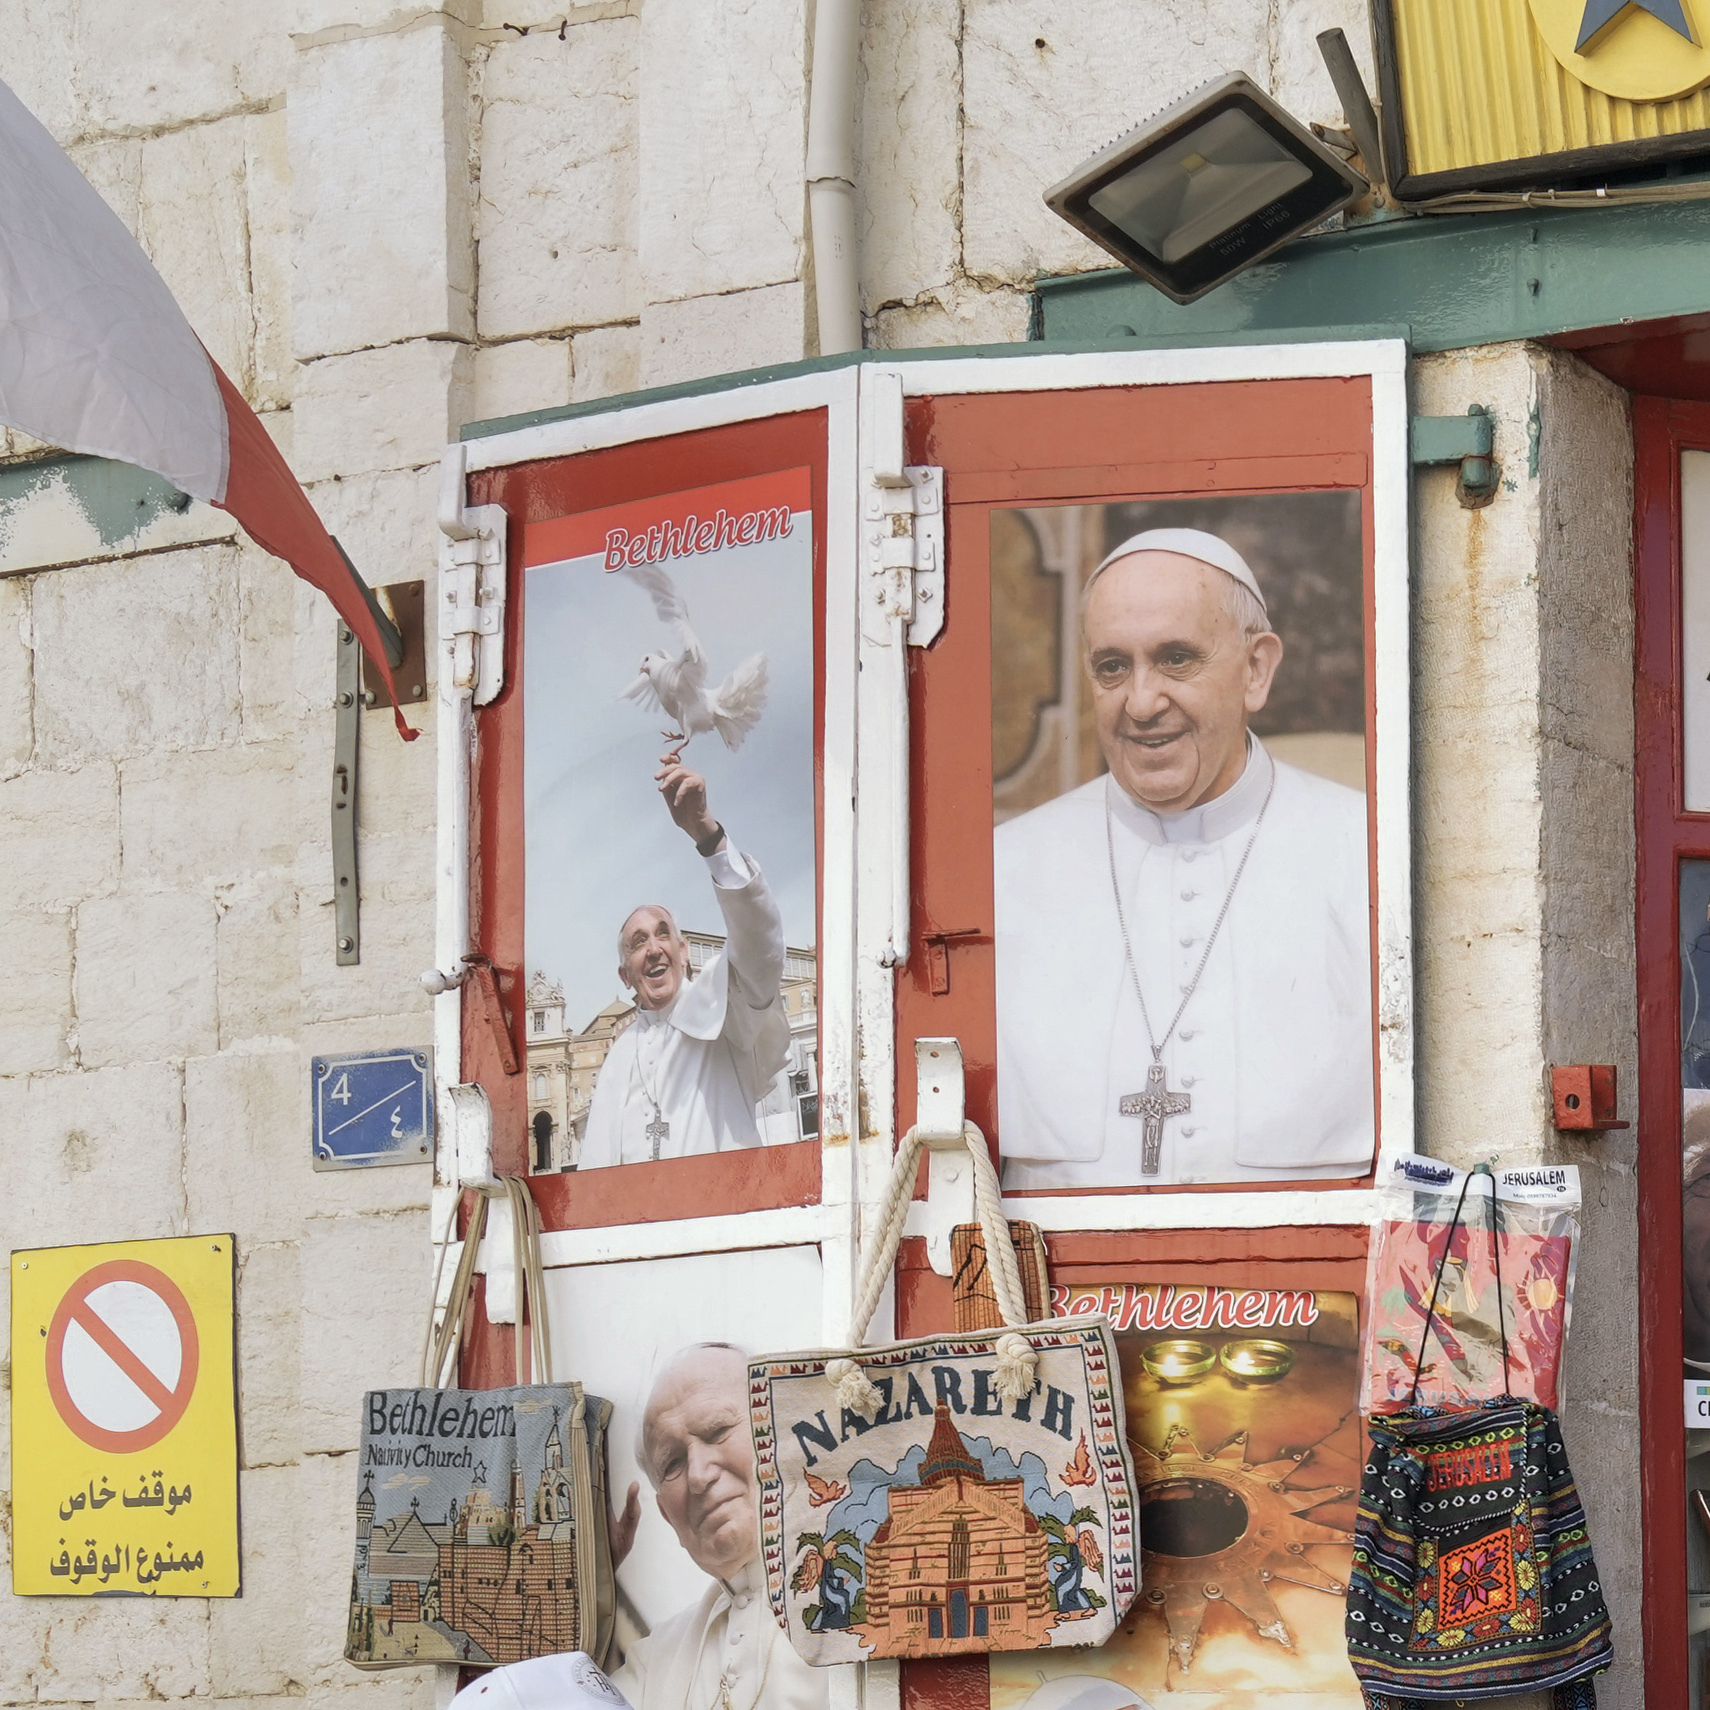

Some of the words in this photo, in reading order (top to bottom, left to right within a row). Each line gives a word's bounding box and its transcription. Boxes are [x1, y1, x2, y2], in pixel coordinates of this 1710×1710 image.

[605, 504, 793, 573] Bethlehem
[331, 1073, 352, 1106] 4
[390, 1105, 403, 1138] ٤
[1502, 1170, 1566, 1186] JERUSALEM
[368, 1391, 516, 1439] Bethlehem
[365, 1439, 413, 1468] Nativity
[413, 1443, 473, 1468] Church
[1427, 1440, 1512, 1492] JERUSALEM
[59, 1476, 116, 1521] خاص
[122, 1470, 192, 1516] موقف
[50, 1537, 130, 1585] الوقوف
[136, 1541, 204, 1584] ممنوع
